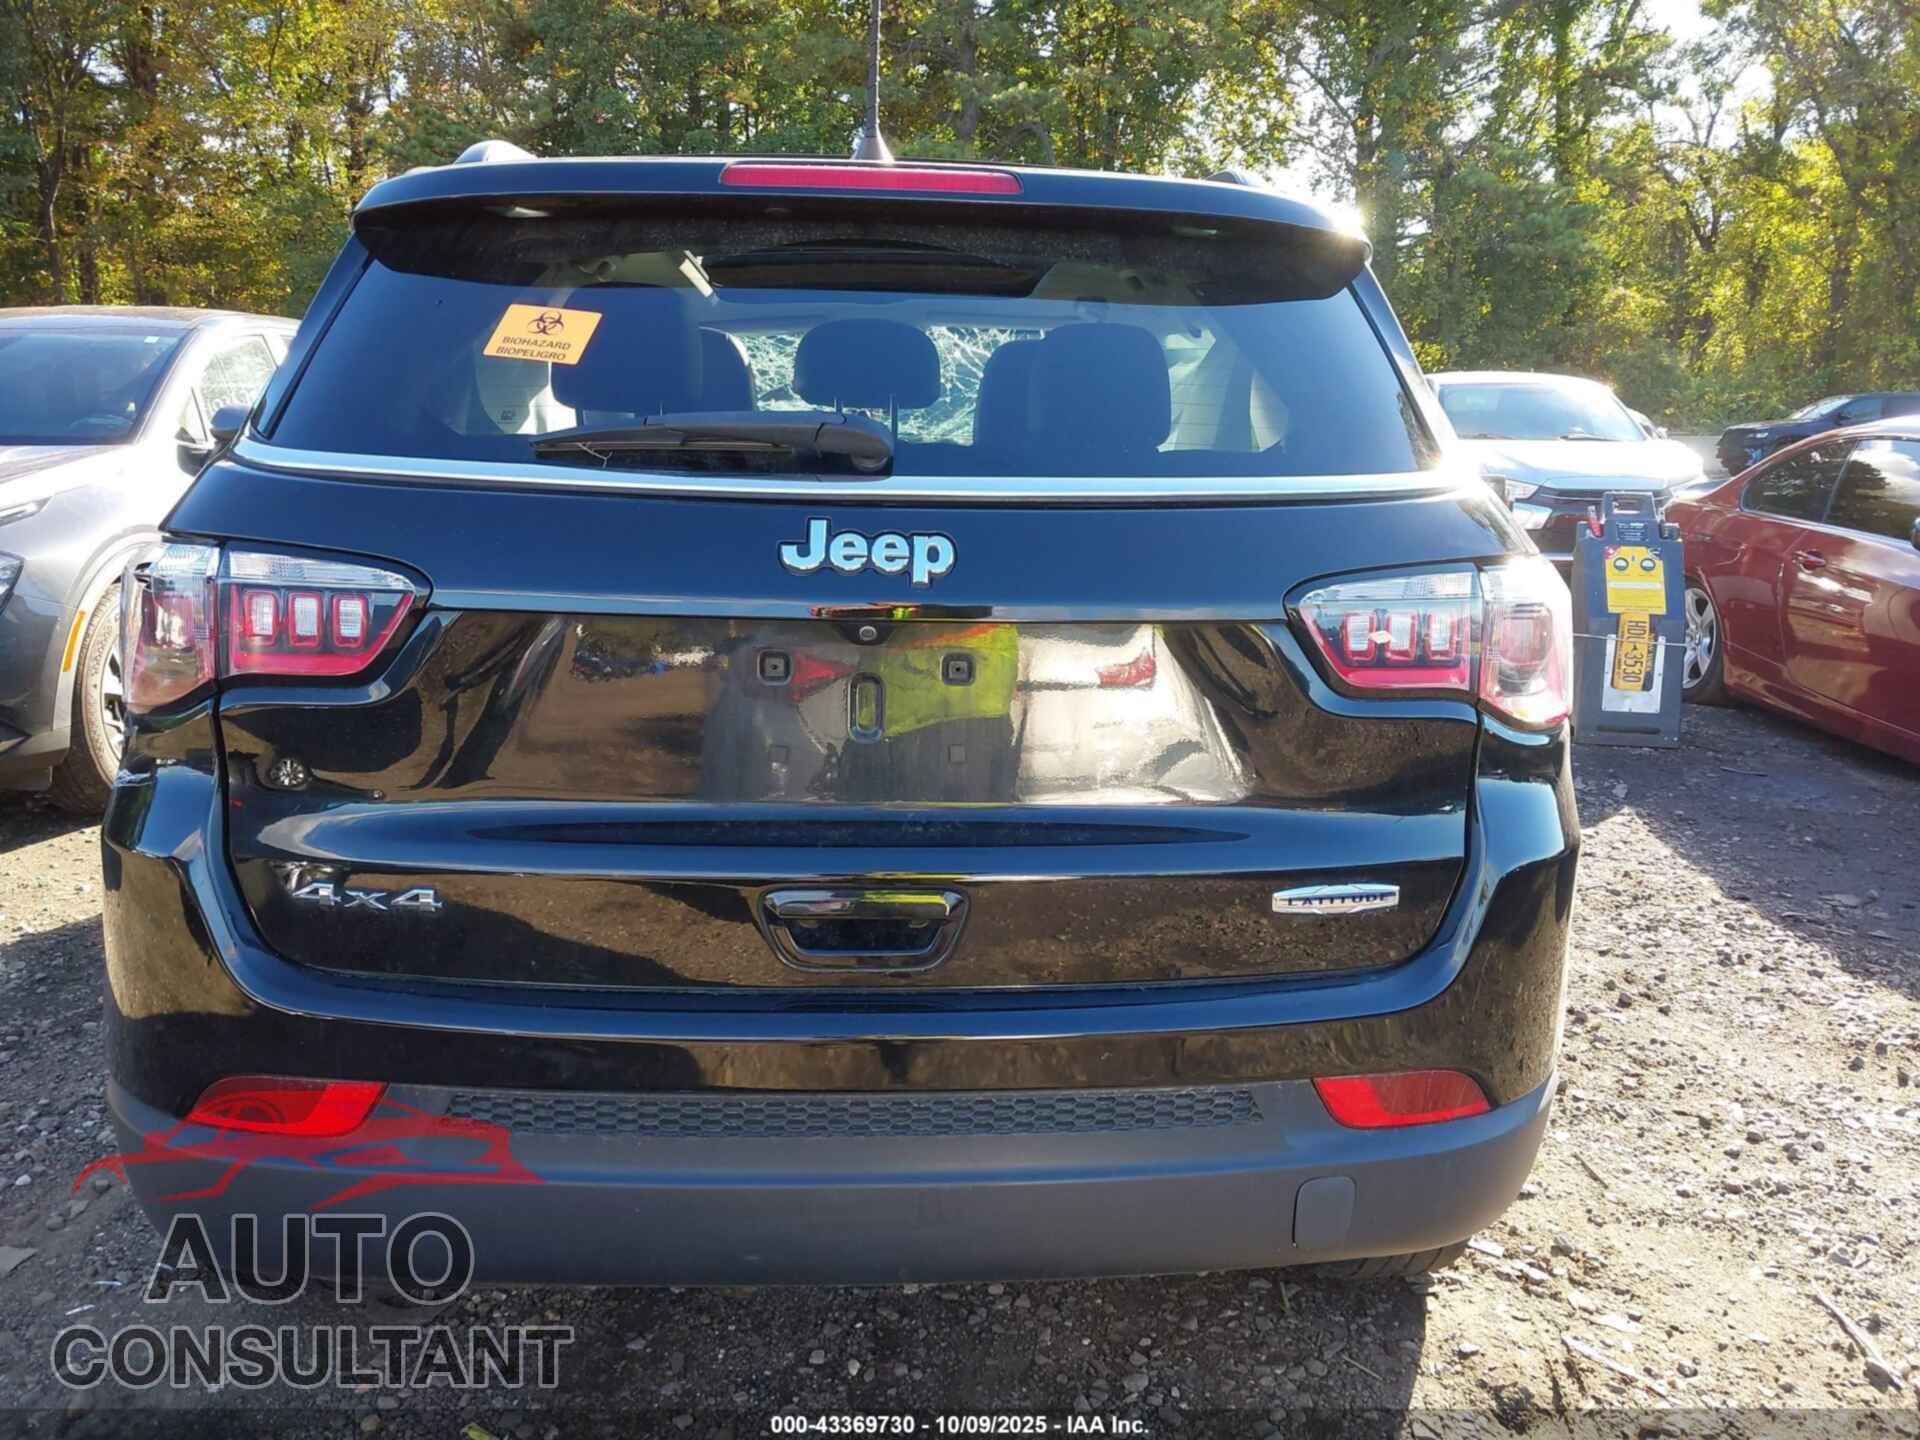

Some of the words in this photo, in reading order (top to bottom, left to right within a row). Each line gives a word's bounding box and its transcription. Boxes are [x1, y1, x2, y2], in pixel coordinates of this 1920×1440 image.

[496, 346, 567, 361] BIOPELIGRO
[502, 336, 572, 350] BIOHAZARD
[780, 518, 956, 585] Jeep
[292, 881, 443, 913] 4x4
